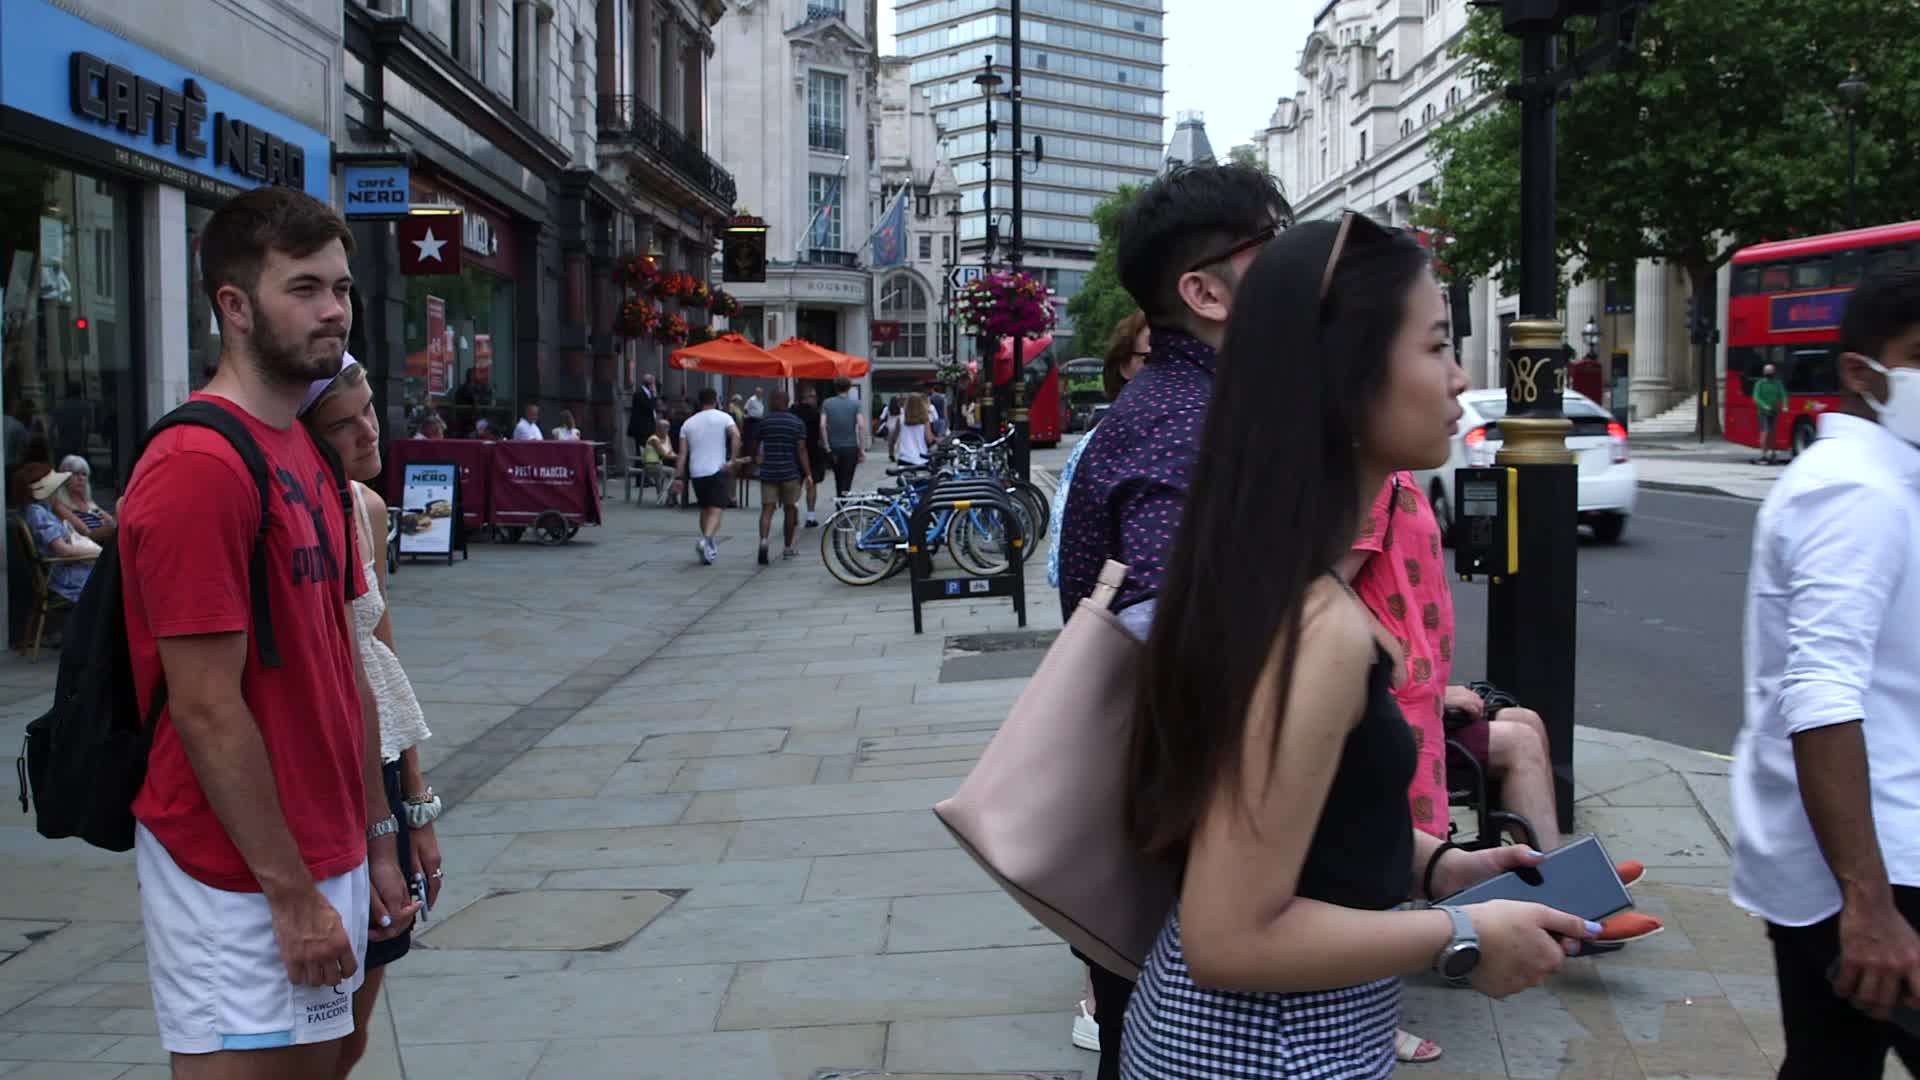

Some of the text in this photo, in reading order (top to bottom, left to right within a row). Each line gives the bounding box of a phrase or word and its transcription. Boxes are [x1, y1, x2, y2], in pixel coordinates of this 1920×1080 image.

[213, 111, 305, 192] NERO
[114, 149, 129, 163] THE
[130, 154, 161, 173] ITALIAN
[161, 164, 188, 184] COFFEE
[200, 179, 215, 192] AND
[348, 190, 405, 203] NERO
[411, 473, 448, 482] NERO
[307, 1003, 349, 1024] FALCONS
